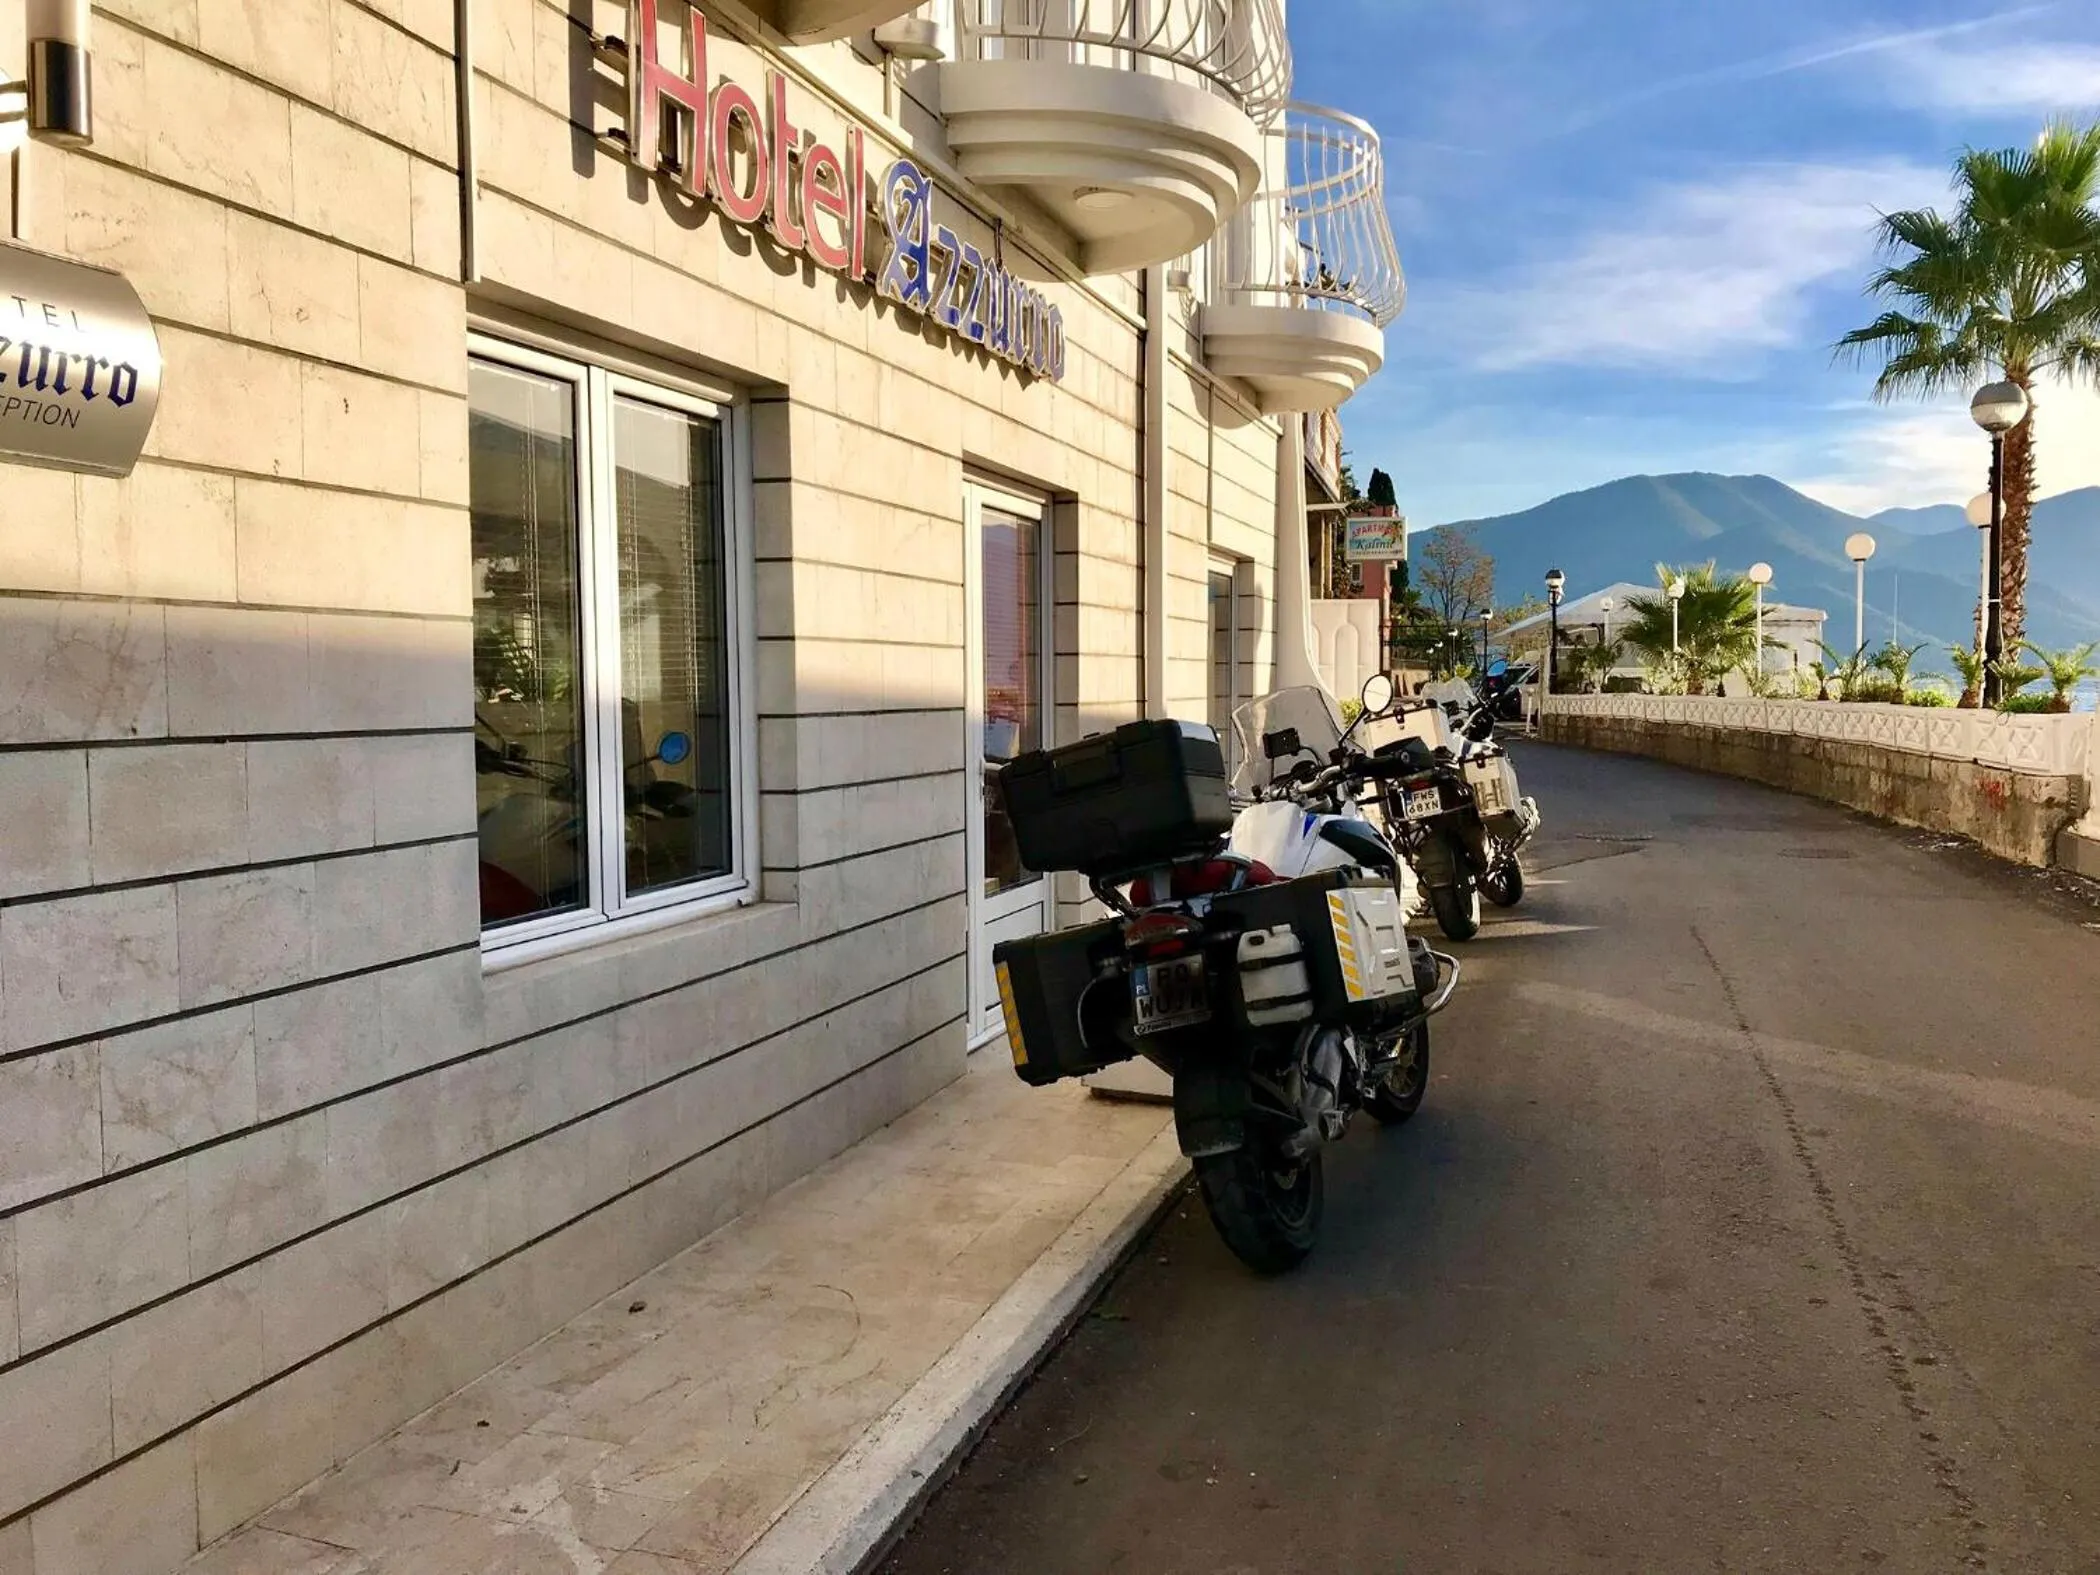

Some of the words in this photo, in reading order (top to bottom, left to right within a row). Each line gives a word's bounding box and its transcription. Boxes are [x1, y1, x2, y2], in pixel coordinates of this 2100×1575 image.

[633, 0, 864, 282] Hotel
[879, 159, 1065, 383] Azzurro
[0, 394, 81, 429] PTION
[1413, 790, 1435, 801] FWS
